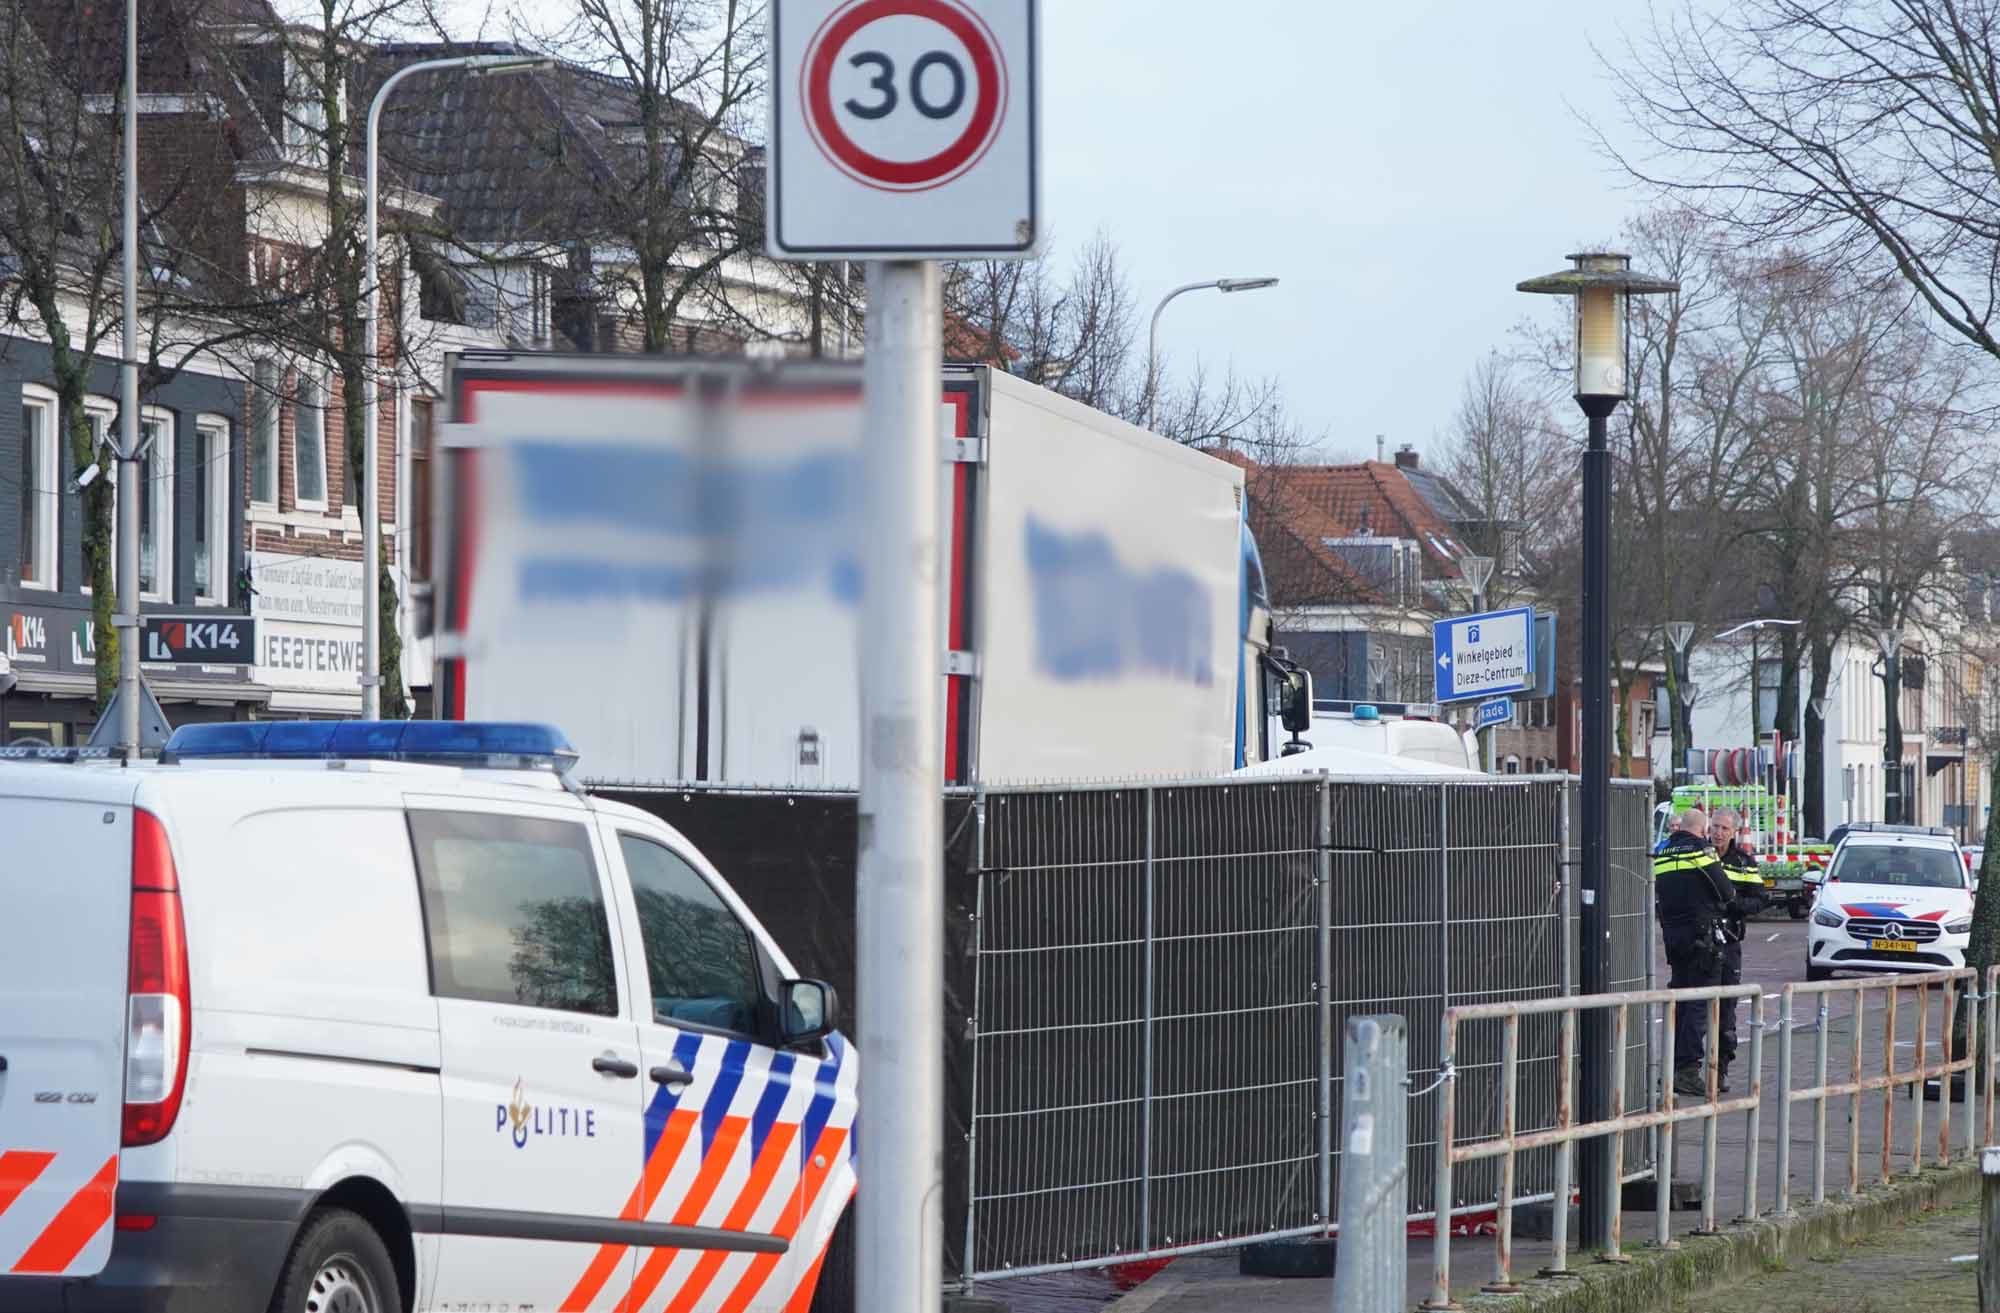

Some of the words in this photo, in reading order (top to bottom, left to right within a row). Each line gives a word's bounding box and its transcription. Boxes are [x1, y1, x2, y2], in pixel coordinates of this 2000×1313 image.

[844, 50, 966, 120] 30
[22, 615, 46, 649] K14
[185, 623, 240, 649] K14
[264, 634, 363, 673] EESTERWE
[1456, 645, 1513, 665] Winkelgebied
[1457, 665, 1524, 686] Dieze-Centrum
[496, 1103, 595, 1148] POLITIE
